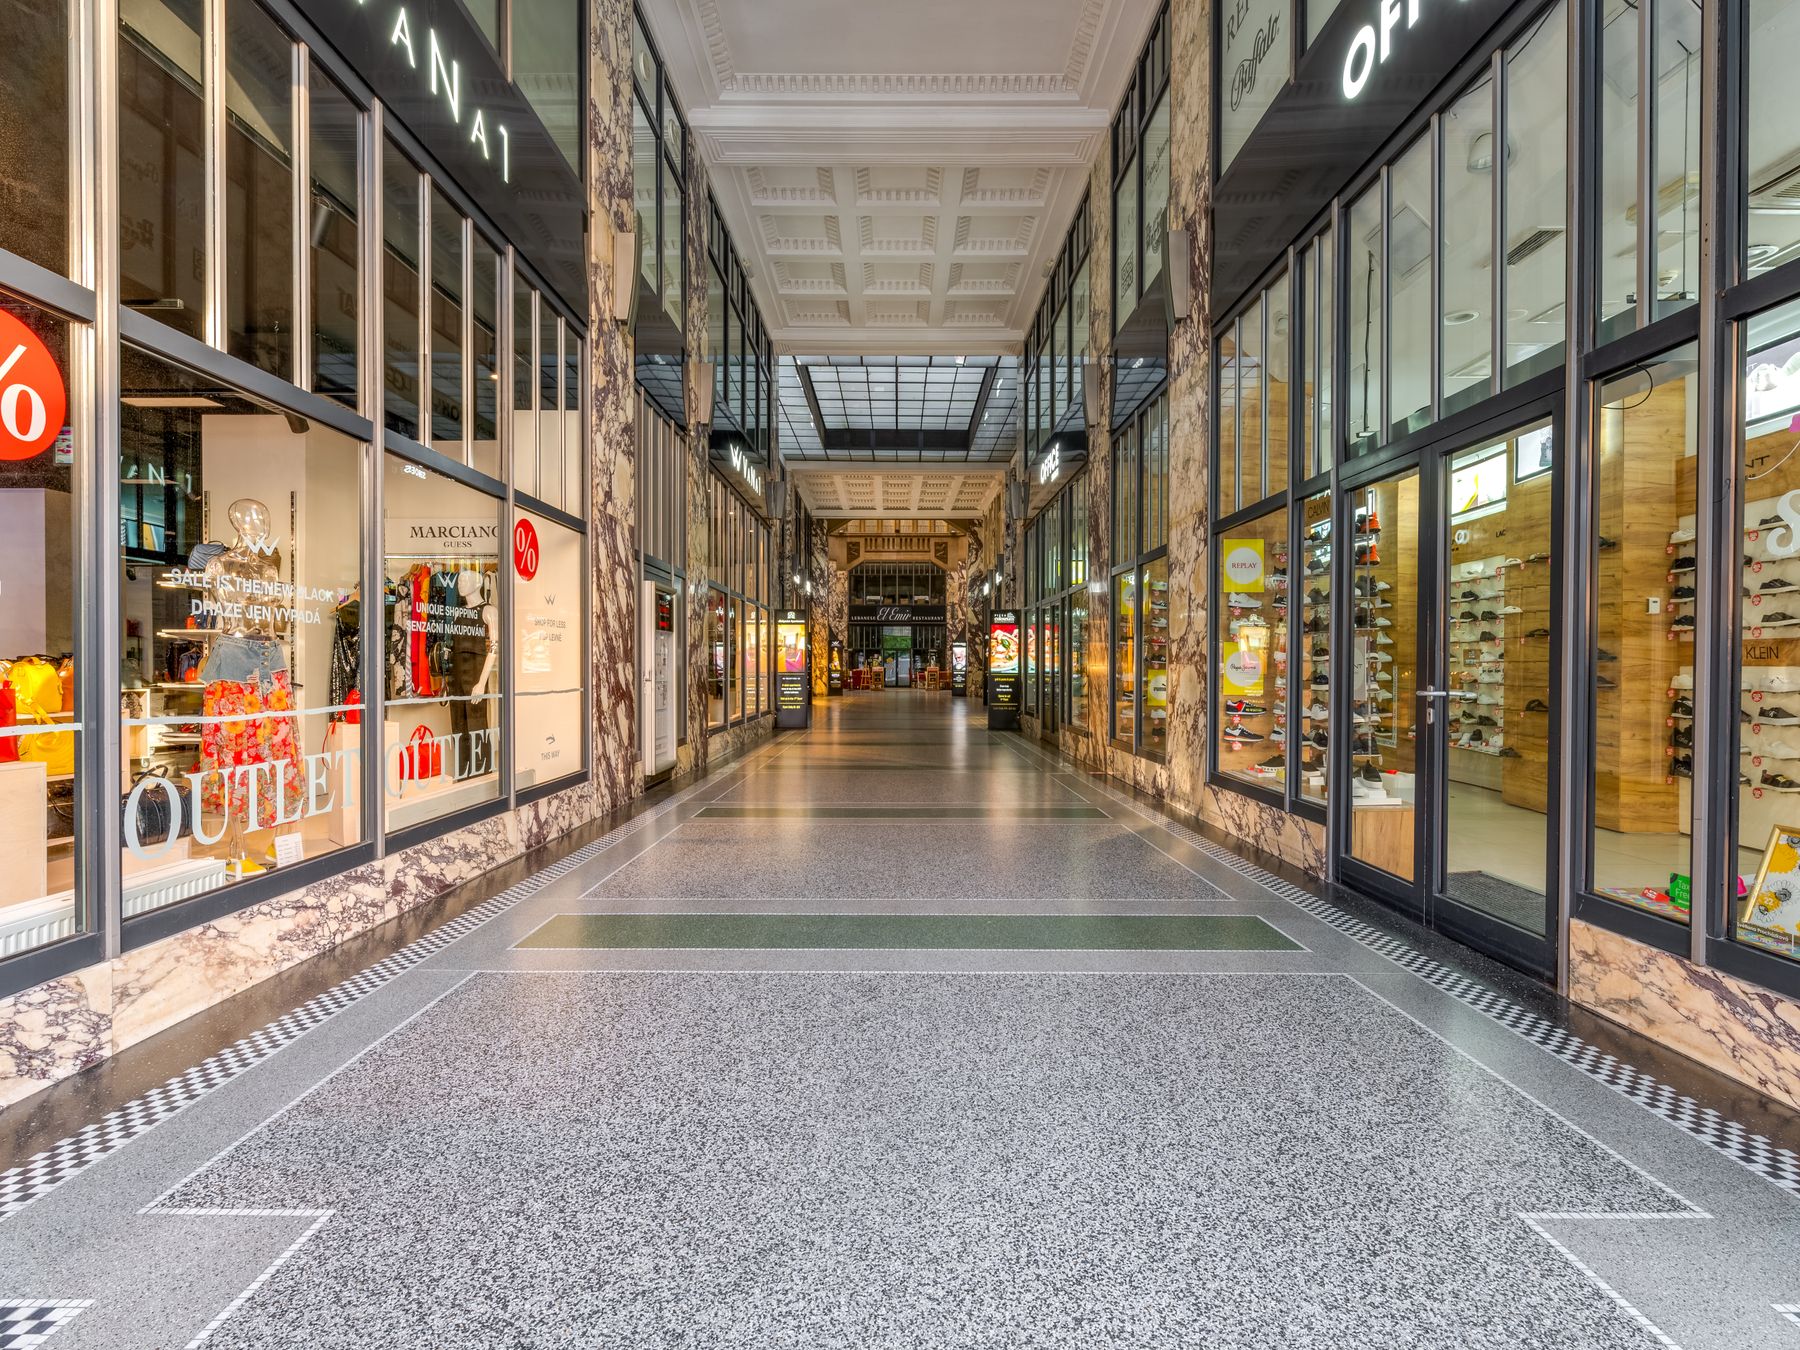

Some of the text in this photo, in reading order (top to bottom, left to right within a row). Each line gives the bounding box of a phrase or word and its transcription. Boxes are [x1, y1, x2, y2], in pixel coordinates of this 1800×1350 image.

[1308, 500, 1330, 518] CALVIN
[171, 568, 212, 589] SALE
[216, 574, 232, 592] IS
[234, 577, 264, 594] THE
[265, 581, 295, 599] NEW
[246, 606, 272, 623] JEN
[275, 608, 322, 625] VYPADÁ
[415, 602, 480, 620] UNIQUE SHOPPING
[889, 607, 912, 621] Emir
[1745, 646, 1780, 660] KLEIN
[385, 727, 500, 798] OUTLET
[541, 750, 560, 761] THIS WAY
[123, 748, 361, 861] OUTLET
[1675, 888, 1690, 900] Fre
